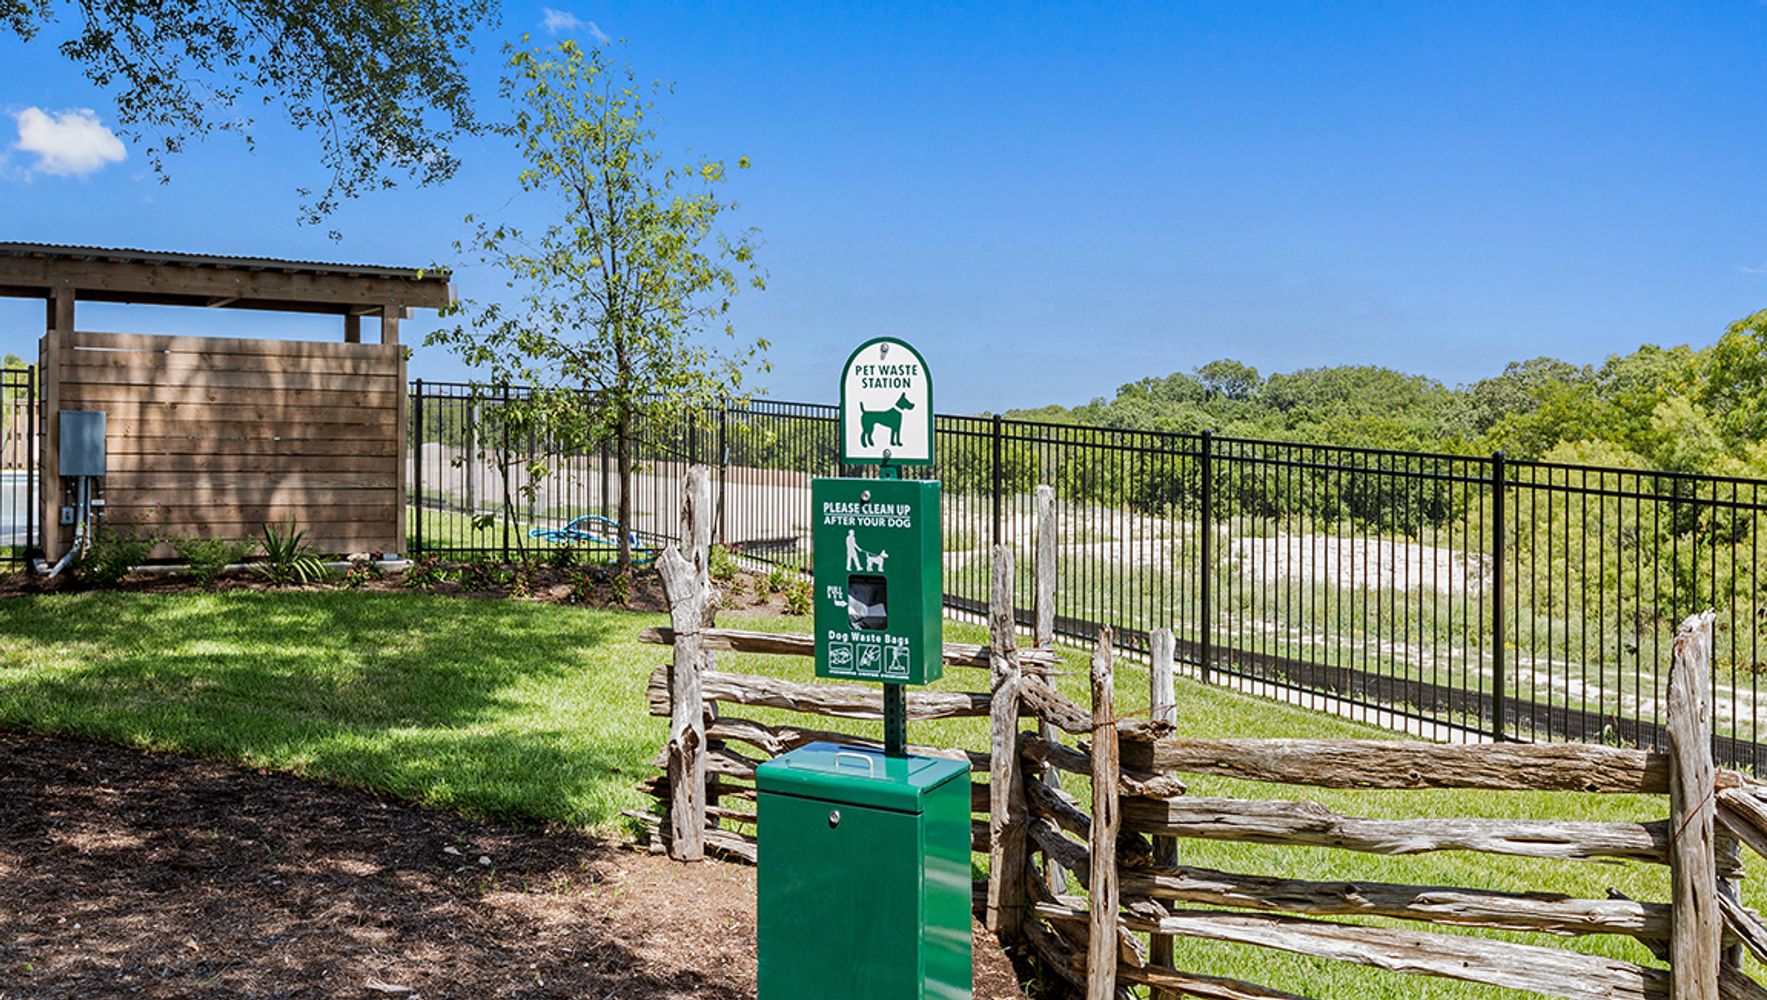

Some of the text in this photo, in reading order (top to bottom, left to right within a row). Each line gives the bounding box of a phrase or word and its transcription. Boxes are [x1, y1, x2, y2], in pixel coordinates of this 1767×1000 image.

[855, 365, 918, 376] PET WASTE
[862, 377, 911, 389] STATION
[823, 502, 911, 516] PLEASE CLEAN UP
[824, 516, 911, 528] AFTER YOUR DOG
[828, 630, 909, 646] Dog Waste Bags
